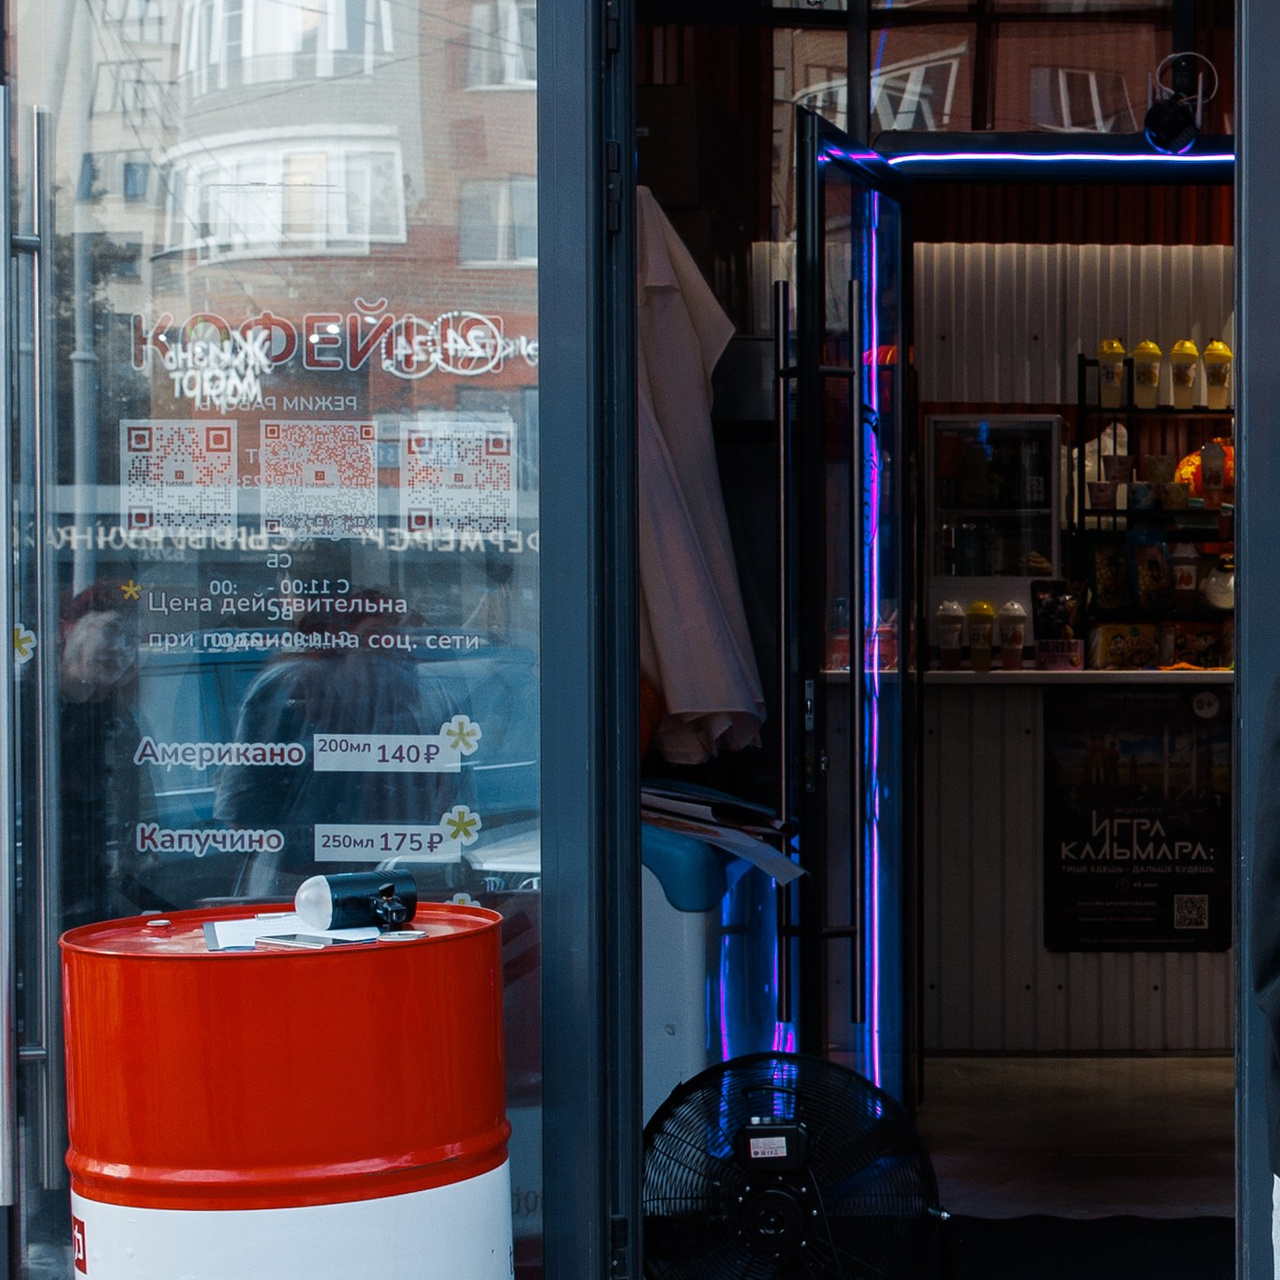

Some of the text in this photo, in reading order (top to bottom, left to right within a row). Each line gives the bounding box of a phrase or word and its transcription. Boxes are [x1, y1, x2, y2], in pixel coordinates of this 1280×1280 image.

[149, 592, 408, 615] Цена действительна
[149, 632, 194, 654] при
[367, 633, 418, 654] соц.
[425, 634, 480, 650] сети
[137, 739, 305, 769] Американо
[318, 738, 371, 753] 200мл
[1091, 808, 1167, 838] ИГРА
[139, 826, 283, 854] Капучино
[321, 834, 374, 849] 250мл
